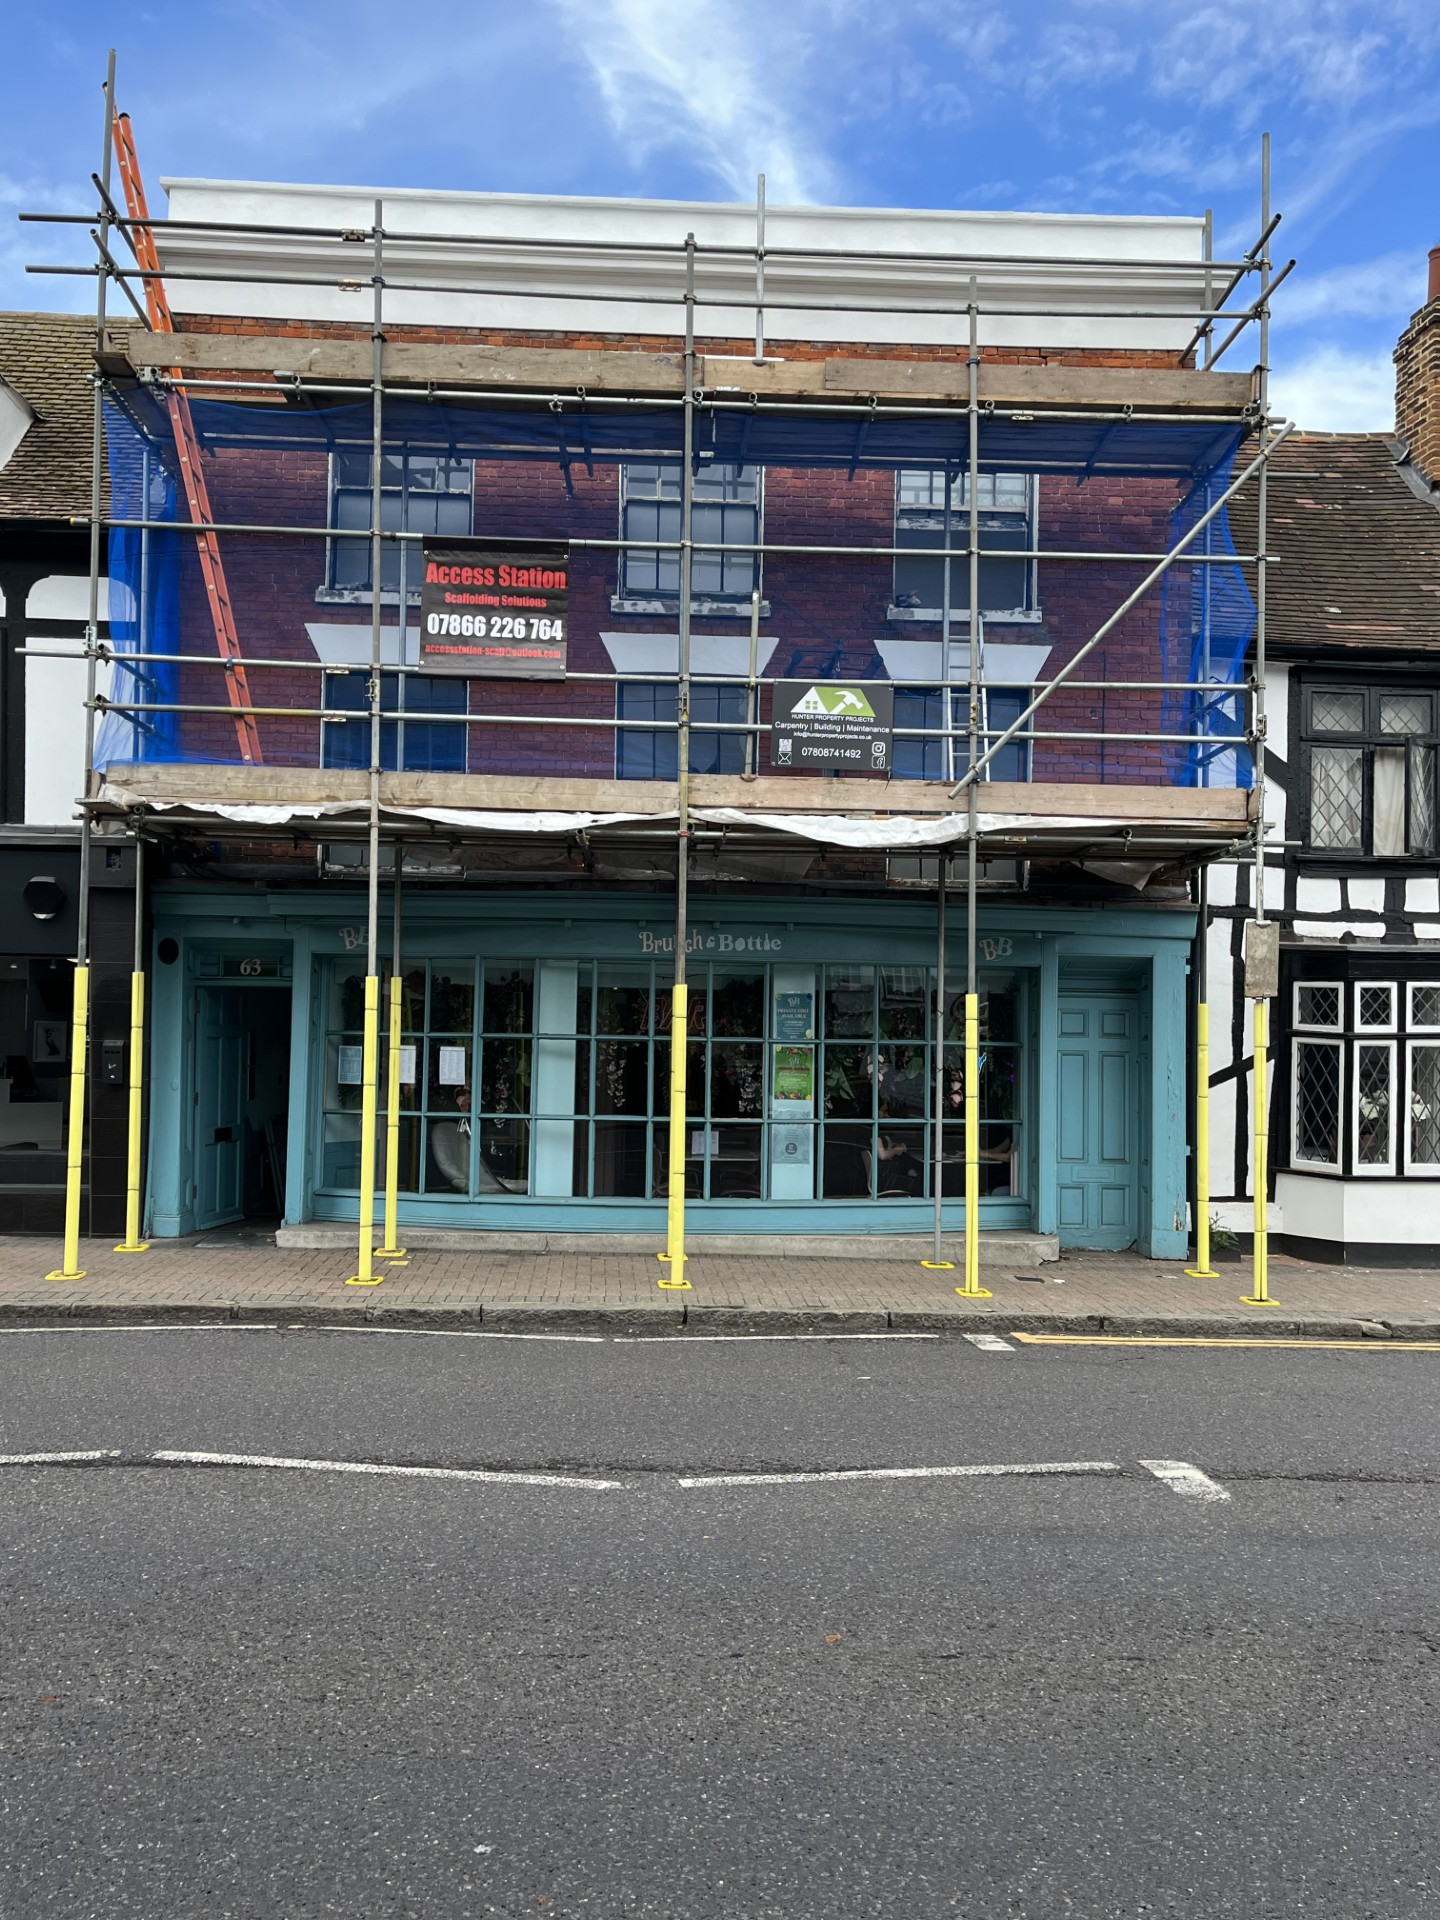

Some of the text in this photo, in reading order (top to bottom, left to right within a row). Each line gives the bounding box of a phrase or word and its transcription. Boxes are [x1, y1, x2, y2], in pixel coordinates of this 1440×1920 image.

[425, 562, 566, 589] Access Station
[444, 591, 547, 608] Scaffolding Solutions
[427, 613, 563, 641] 07866 226 764
[774, 721, 809, 730] Carpentry
[814, 723, 841, 732] Building
[846, 725, 890, 734] Maintenance
[793, 731, 873, 740] info@hunterpropertyprojects.co.uk
[801, 747, 861, 759] 07808741492
[638, 929, 782, 953] Bruch & Bottle
[239, 958, 262, 976] 63
